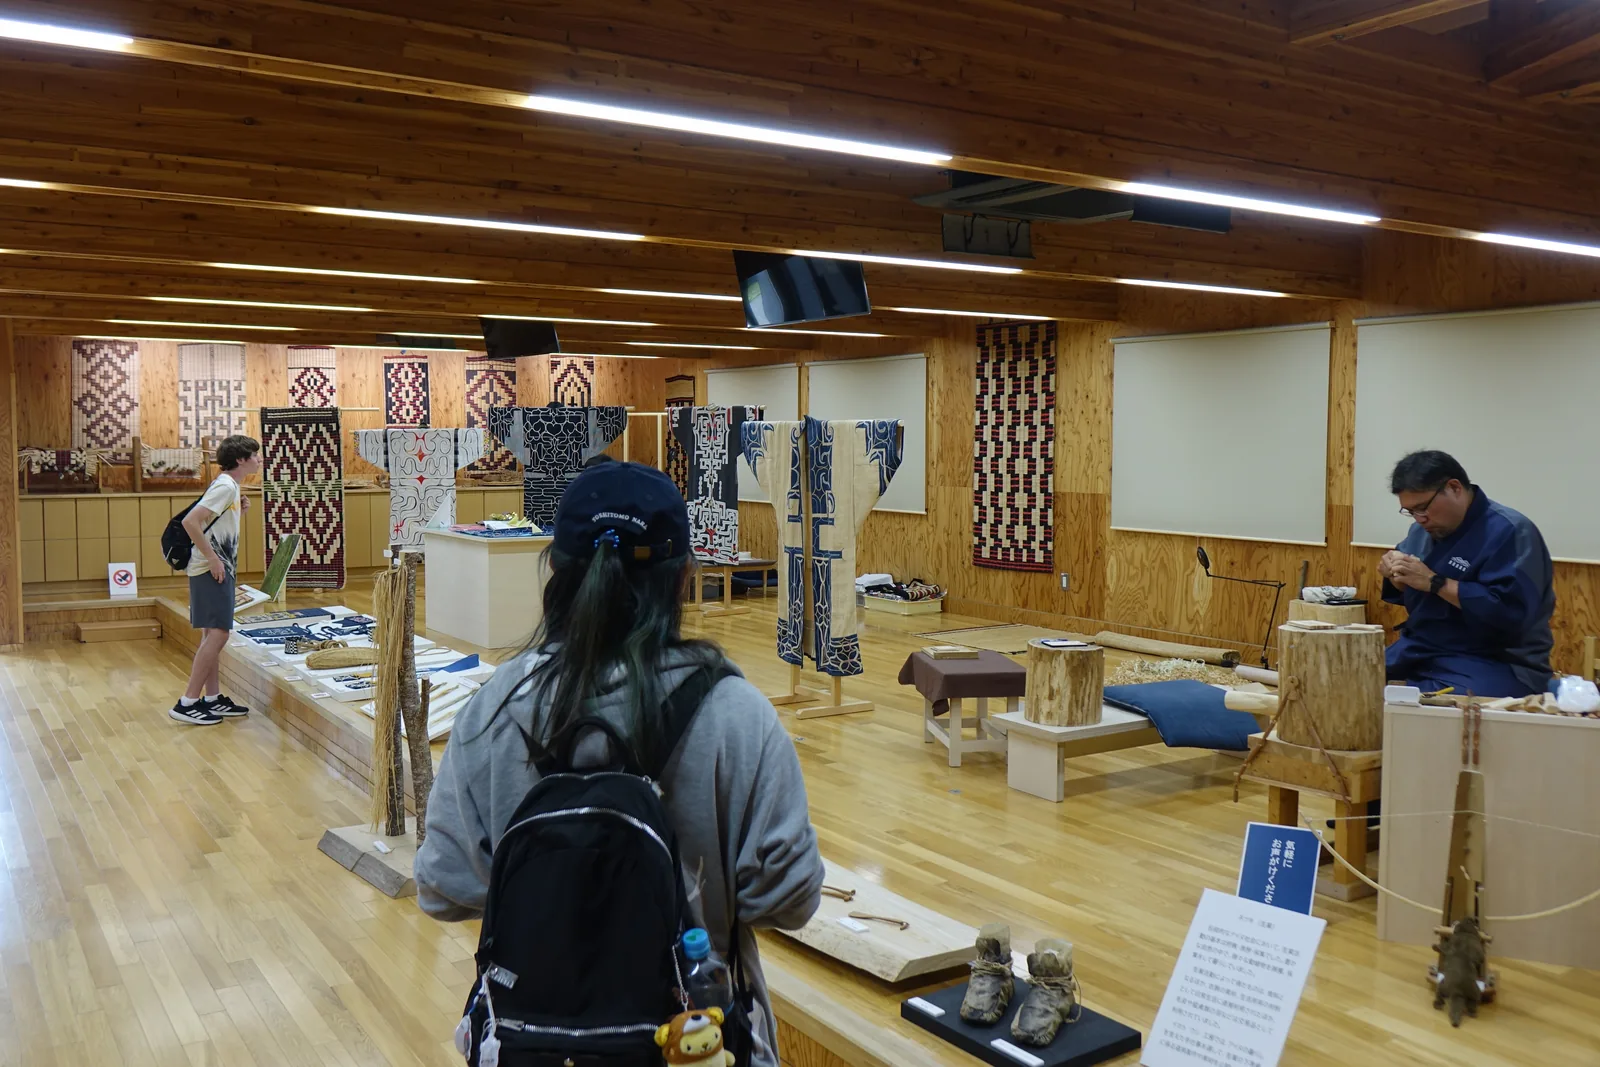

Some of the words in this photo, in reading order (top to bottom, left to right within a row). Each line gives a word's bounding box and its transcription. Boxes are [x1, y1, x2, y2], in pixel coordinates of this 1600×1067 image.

[592, 512, 630, 523] YOSHITOMO
[631, 517, 648, 531] NARA
[1282, 840, 1296, 868] 気軽に
